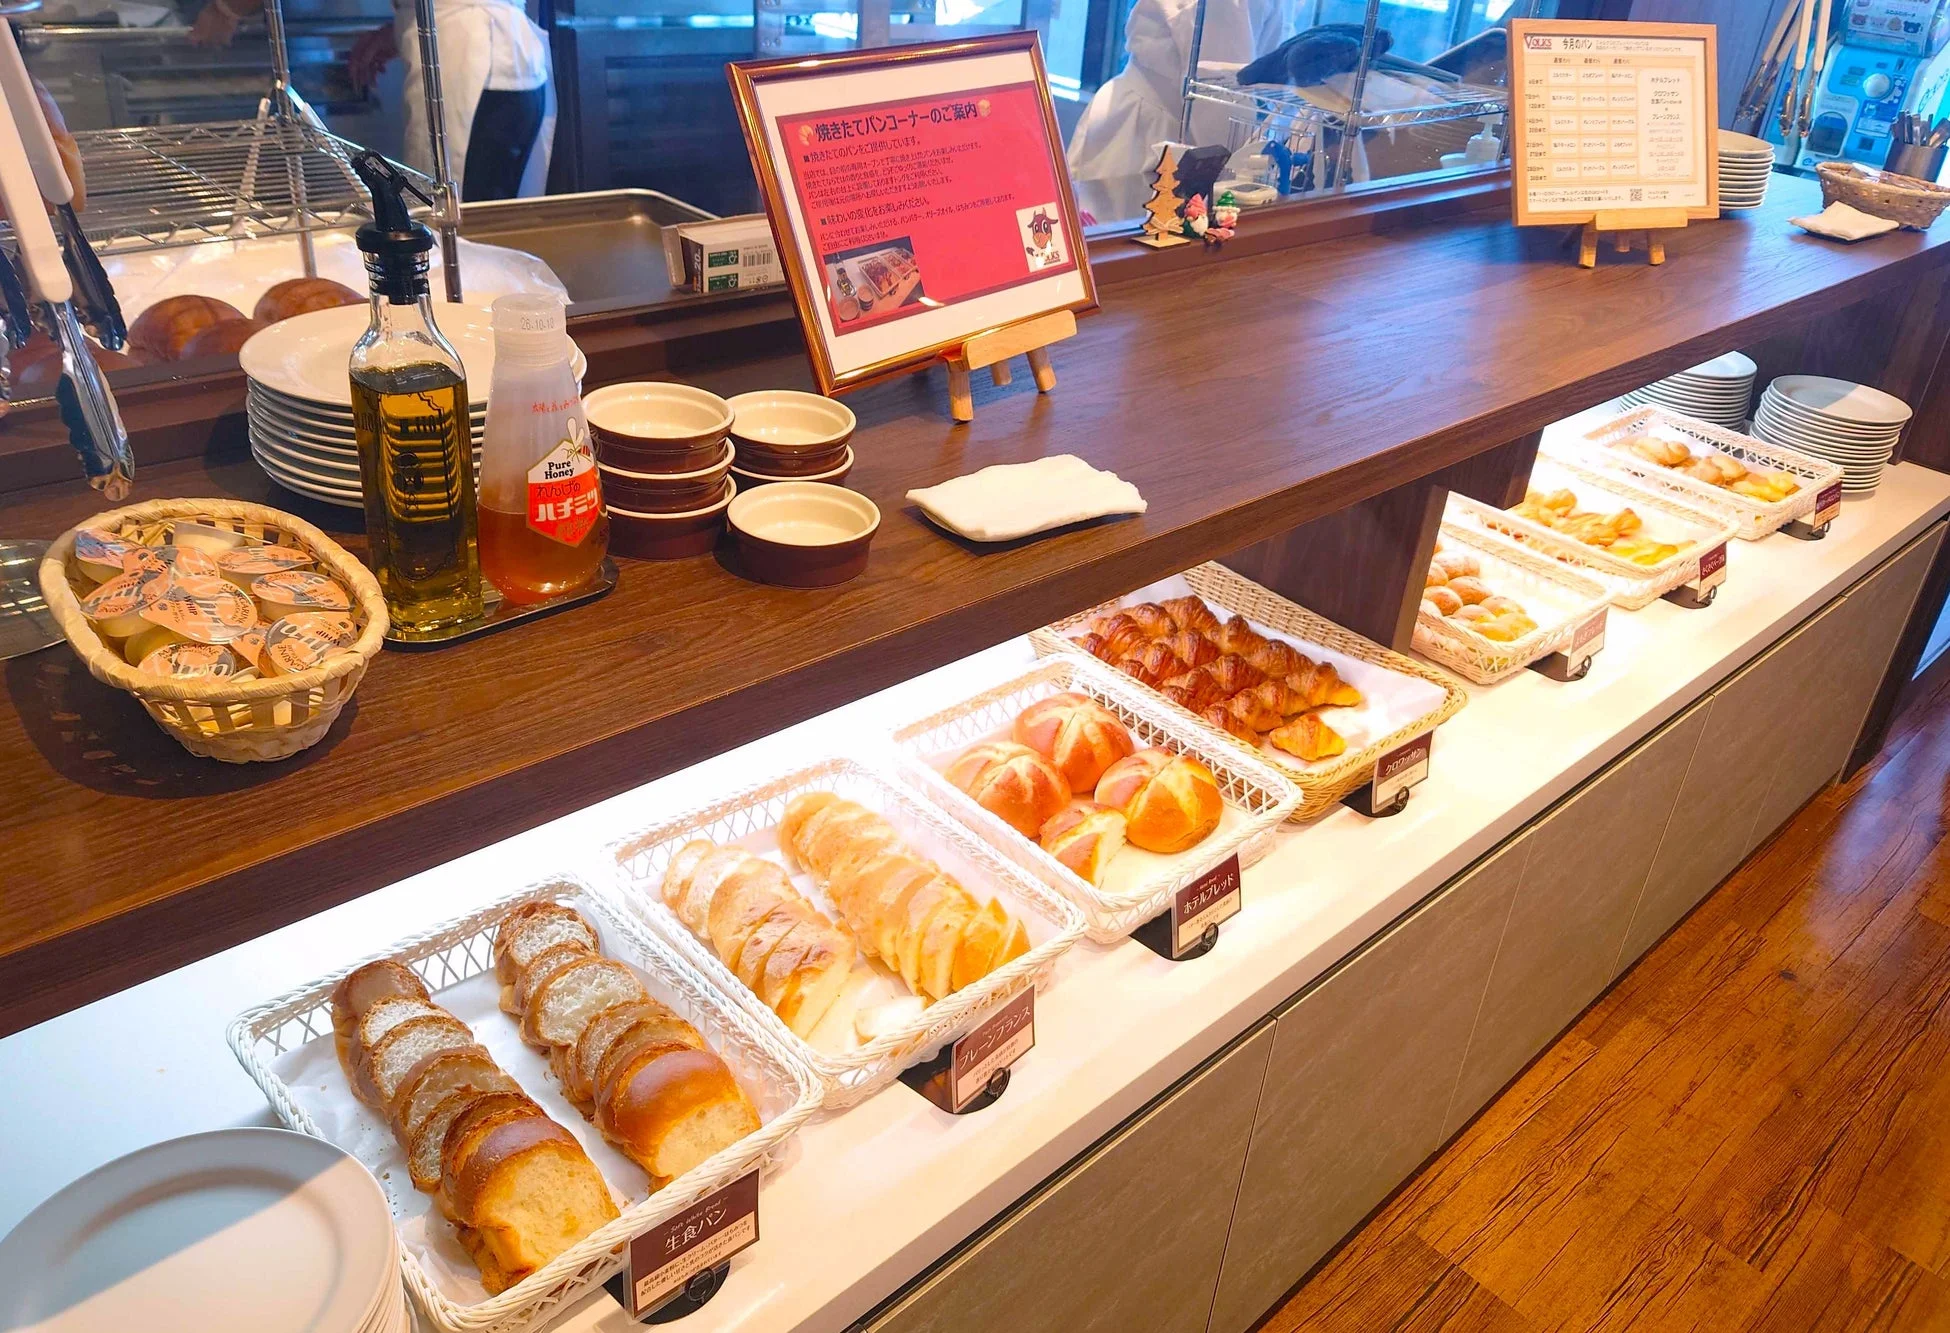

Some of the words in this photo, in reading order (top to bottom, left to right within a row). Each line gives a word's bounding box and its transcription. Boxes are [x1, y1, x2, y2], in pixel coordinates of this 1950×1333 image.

[1524, 35, 1552, 50] VOLKS
[1563, 38, 1593, 50] 今月のパン
[815, 102, 978, 142] 焼きたてパンコーナーのご案内
[827, 195, 930, 224] 味わいの変化をお楽しみください。
[544, 467, 575, 480] Honey
[547, 460, 572, 471] Pure
[537, 480, 581, 498] れんげの
[535, 487, 599, 522] ハチミツ
[183, 595, 198, 616] WHIP
[1385, 748, 1422, 776] クロワッサン
[1183, 872, 1234, 914] ホテルブレッド
[959, 1005, 1031, 1070] プレーンフランス
[665, 1208, 727, 1255] 生食パン
